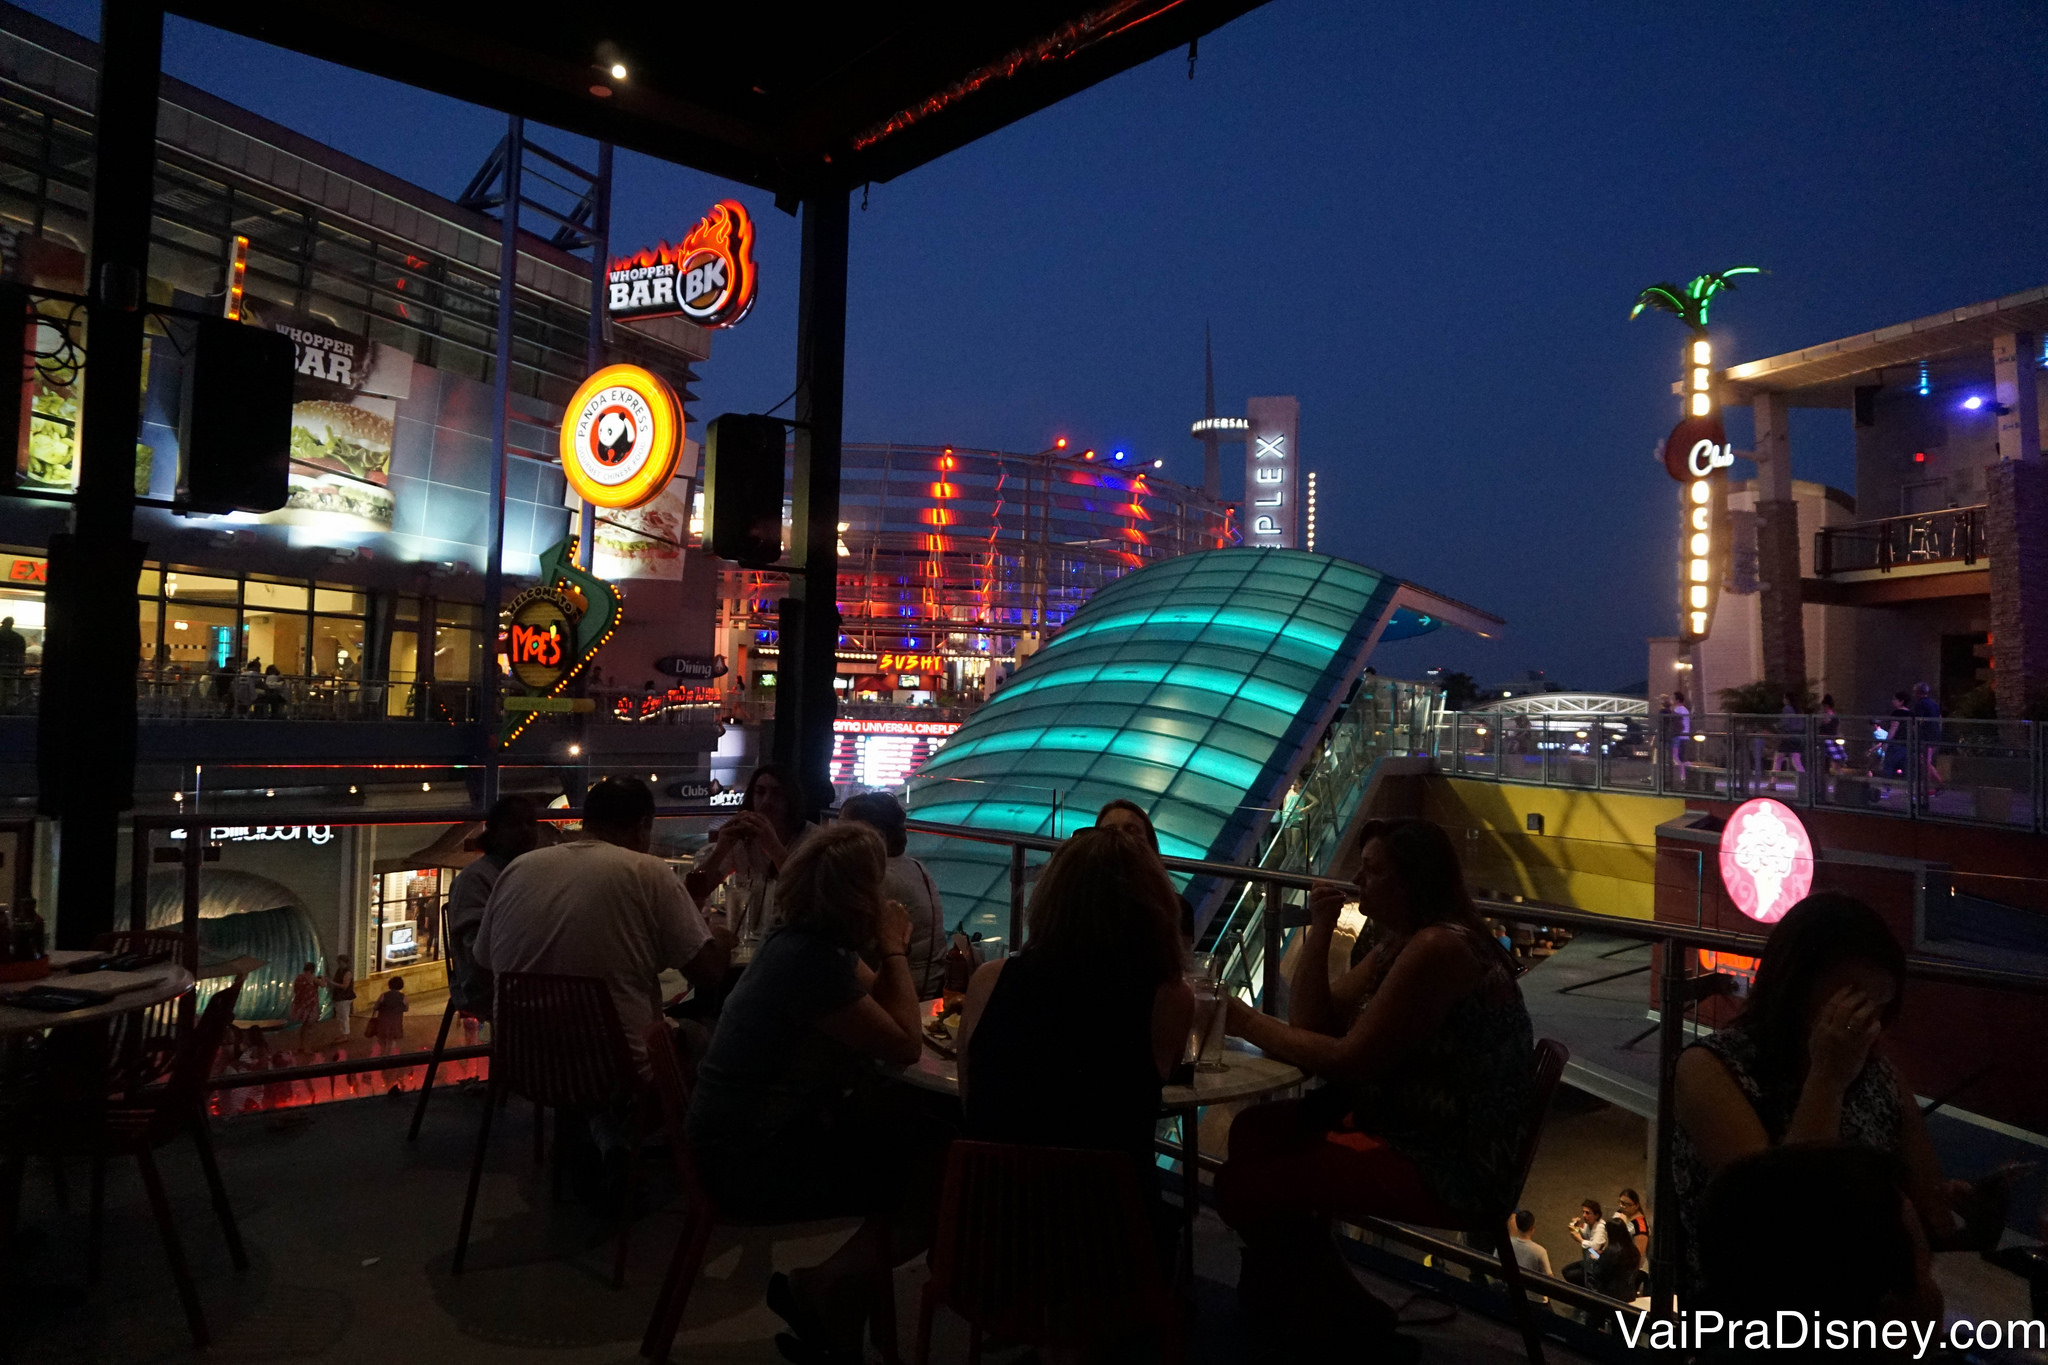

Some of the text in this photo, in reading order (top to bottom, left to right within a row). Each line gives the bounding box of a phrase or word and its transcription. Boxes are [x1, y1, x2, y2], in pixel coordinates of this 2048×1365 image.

[609, 263, 675, 284] WHOPPER
[685, 256, 726, 303] BK
[608, 277, 675, 311] BAR
[275, 323, 355, 357] WHOPPER
[578, 390, 648, 437] PANDA EXPRESS
[1191, 418, 1250, 431] UNIVERSAL
[602, 464, 633, 481] CHINESE
[632, 441, 647, 466] FOOD
[1688, 439, 1735, 477] Club
[508, 587, 574, 614] WELCOME TO
[675, 658, 712, 678] Dining
[879, 654, 942, 671] SUSHI
[833, 721, 861, 732] amc
[862, 722, 915, 734] UNIVERSAL
[681, 785, 709, 797] Clubs
